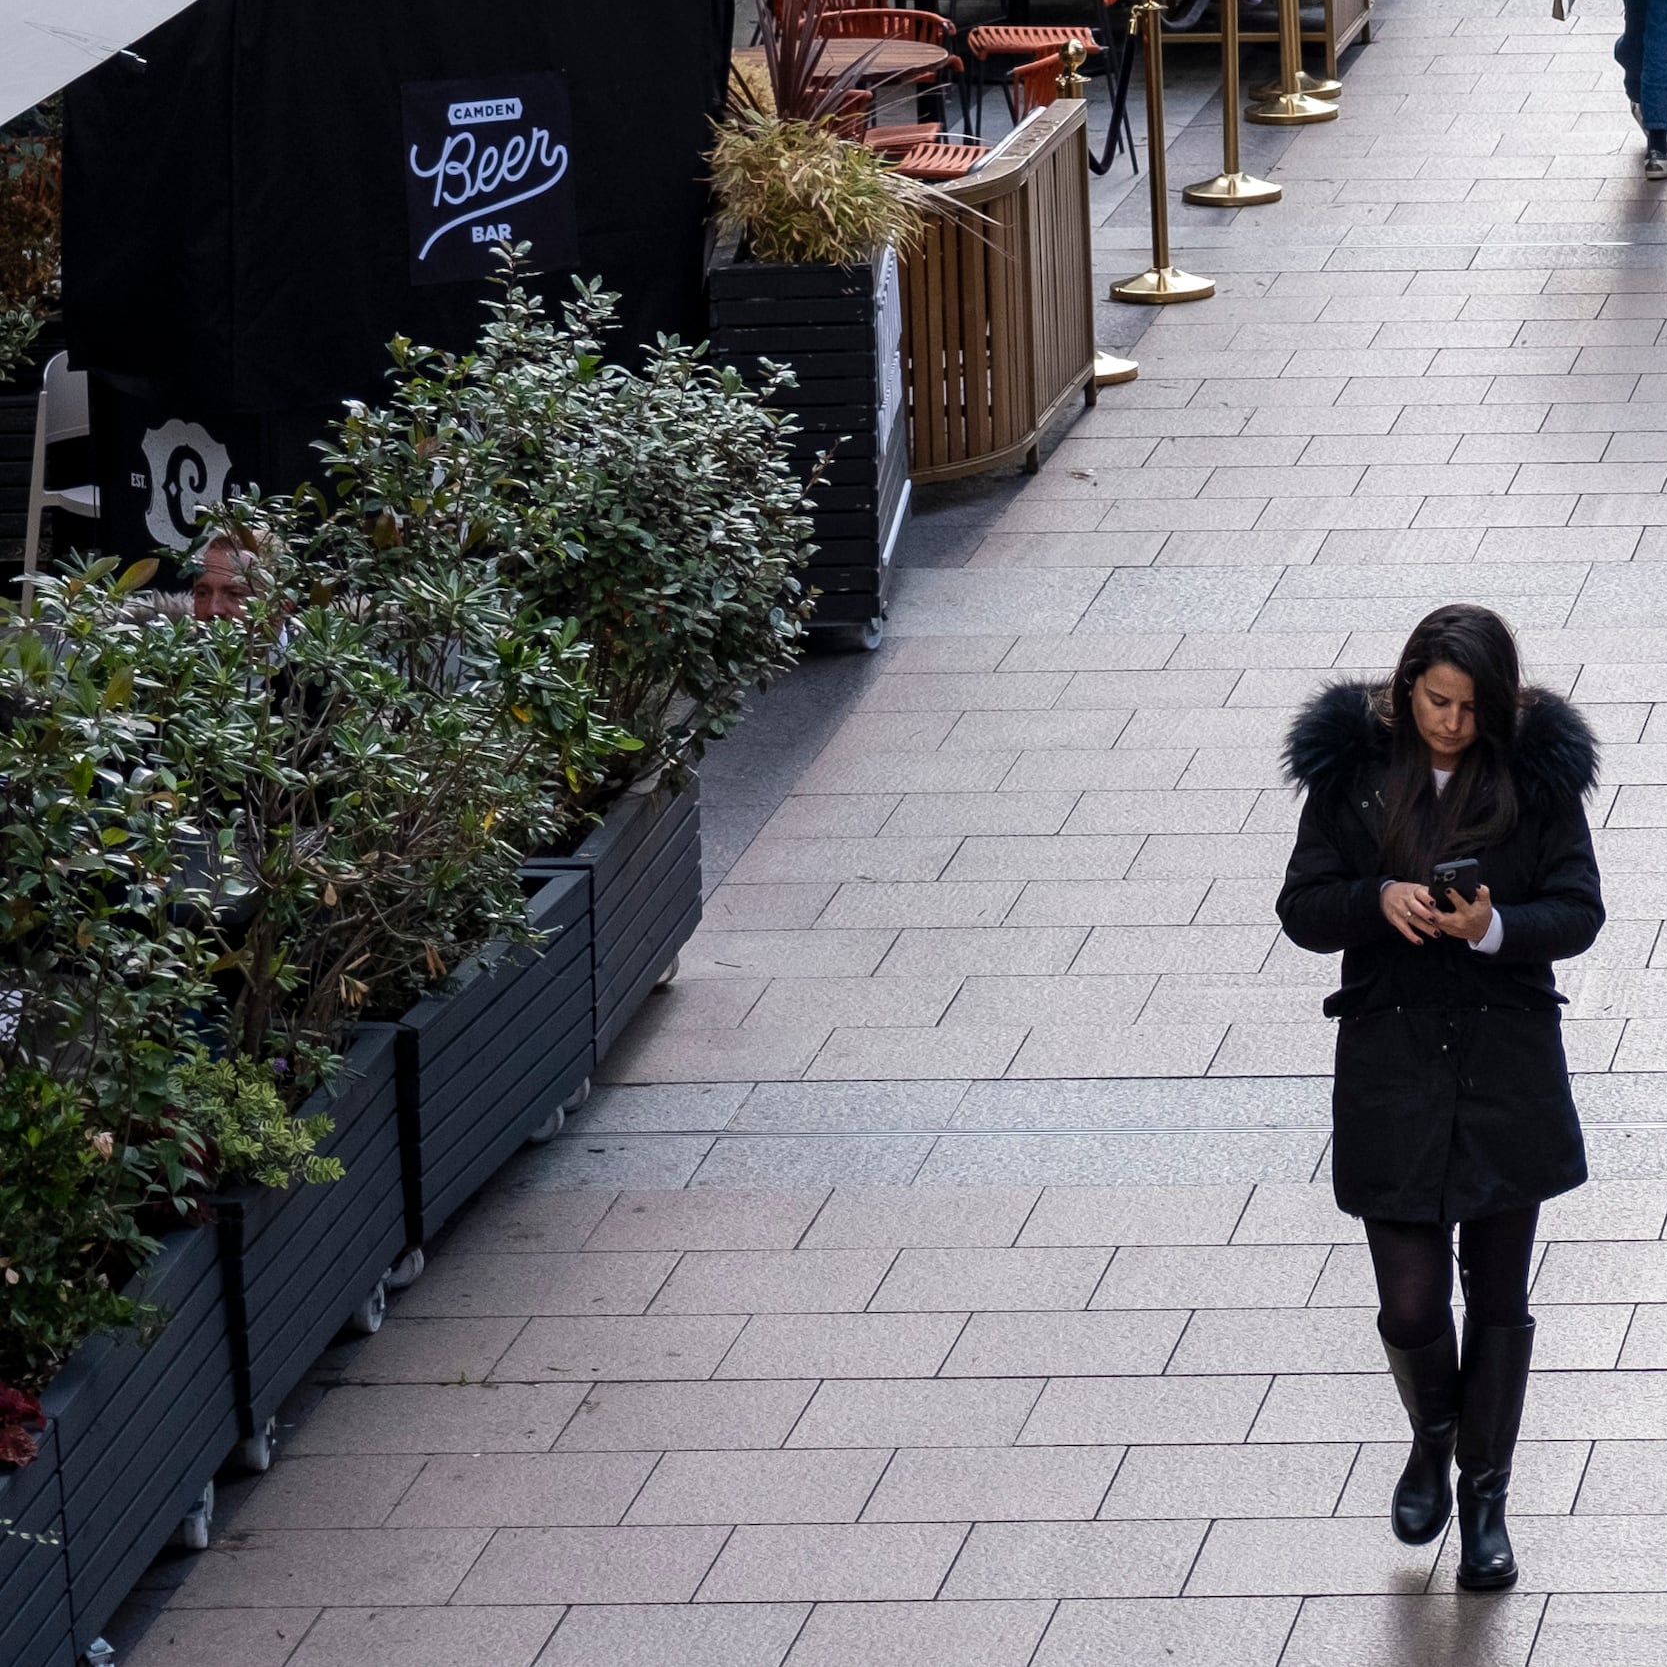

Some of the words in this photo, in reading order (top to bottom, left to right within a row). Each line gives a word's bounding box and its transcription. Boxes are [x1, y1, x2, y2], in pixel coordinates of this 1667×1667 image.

[453, 102, 517, 121] CAMDEN
[409, 126, 569, 212] Beer
[471, 222, 513, 244] BAR
[130, 473, 147, 489] EST.
[162, 443, 209, 539] C
